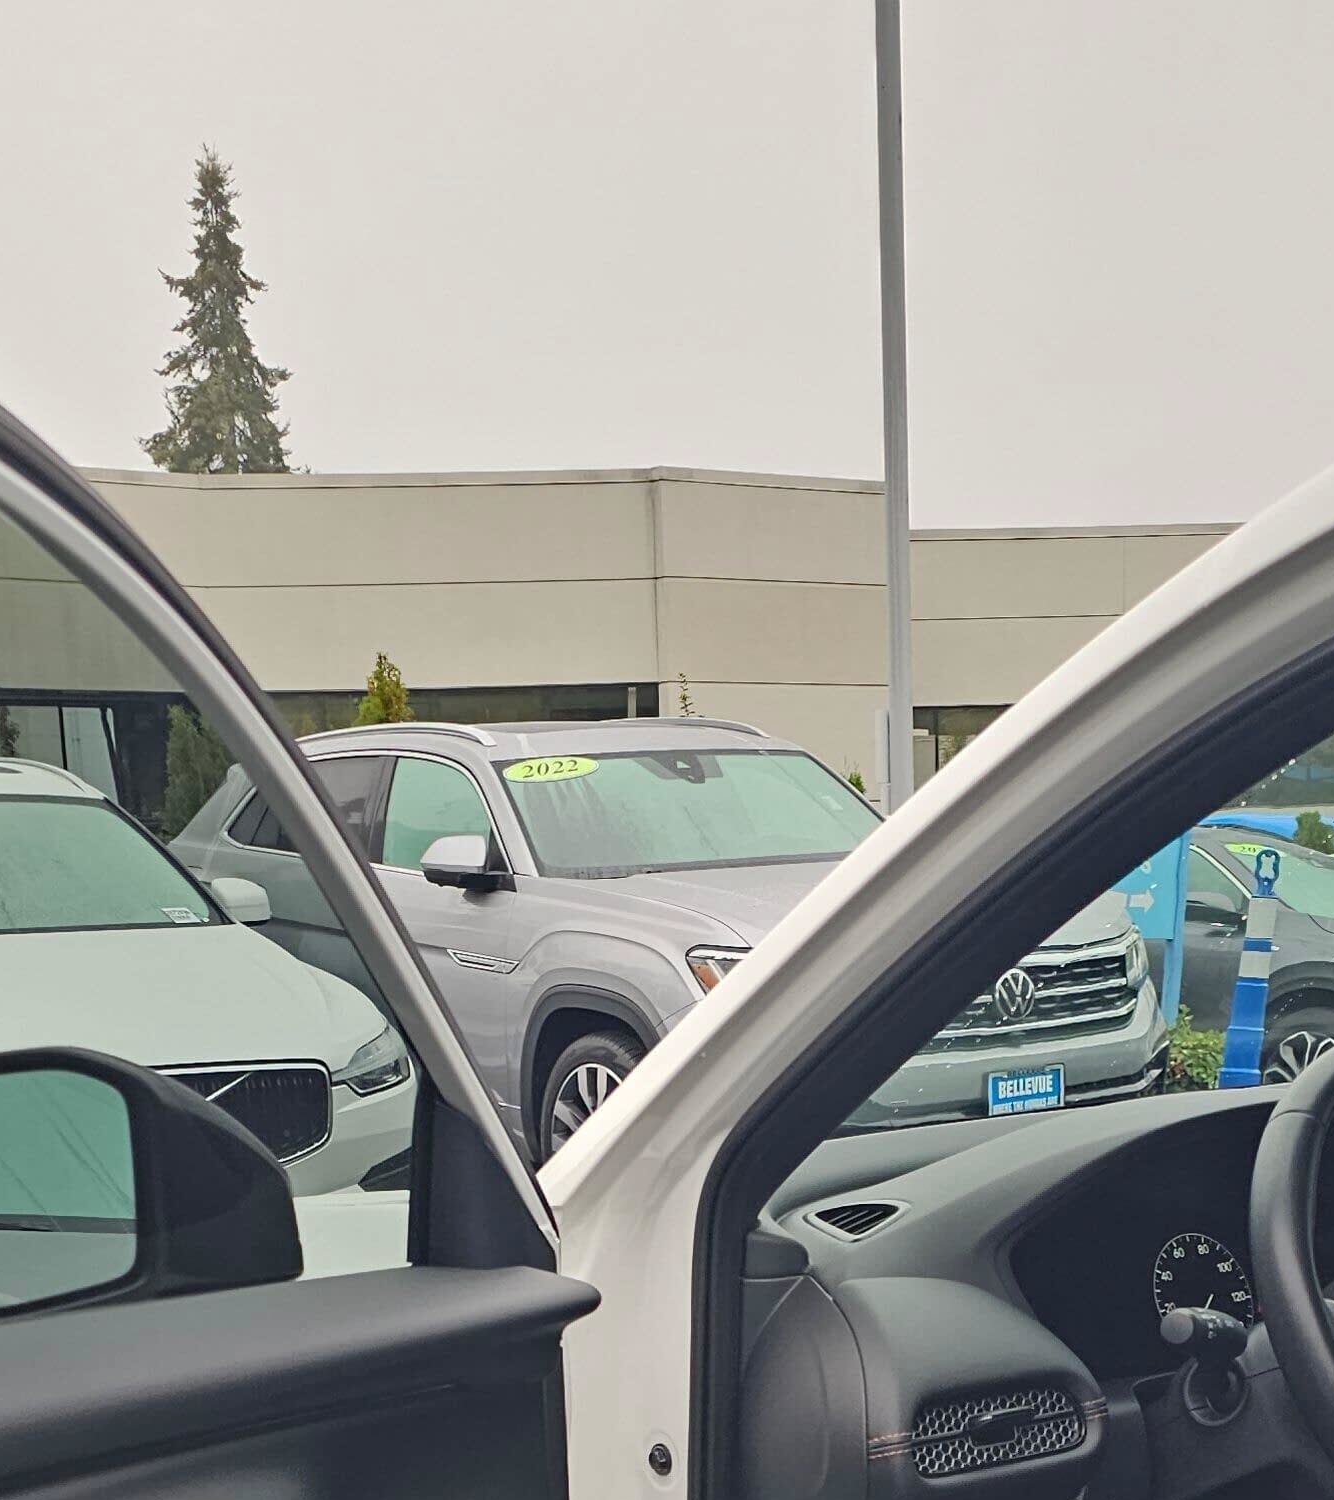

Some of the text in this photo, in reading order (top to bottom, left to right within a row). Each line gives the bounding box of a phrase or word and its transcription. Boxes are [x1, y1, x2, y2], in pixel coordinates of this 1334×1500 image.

[523, 760, 579, 778] 2022
[998, 1075, 1053, 1099] BELLEVUE
[1173, 1247, 1185, 1258] 60
[1197, 1244, 1209, 1255] 80
[1217, 1261, 1232, 1272] 100
[1161, 1271, 1173, 1281] 40
[1231, 1291, 1246, 1302] 120
